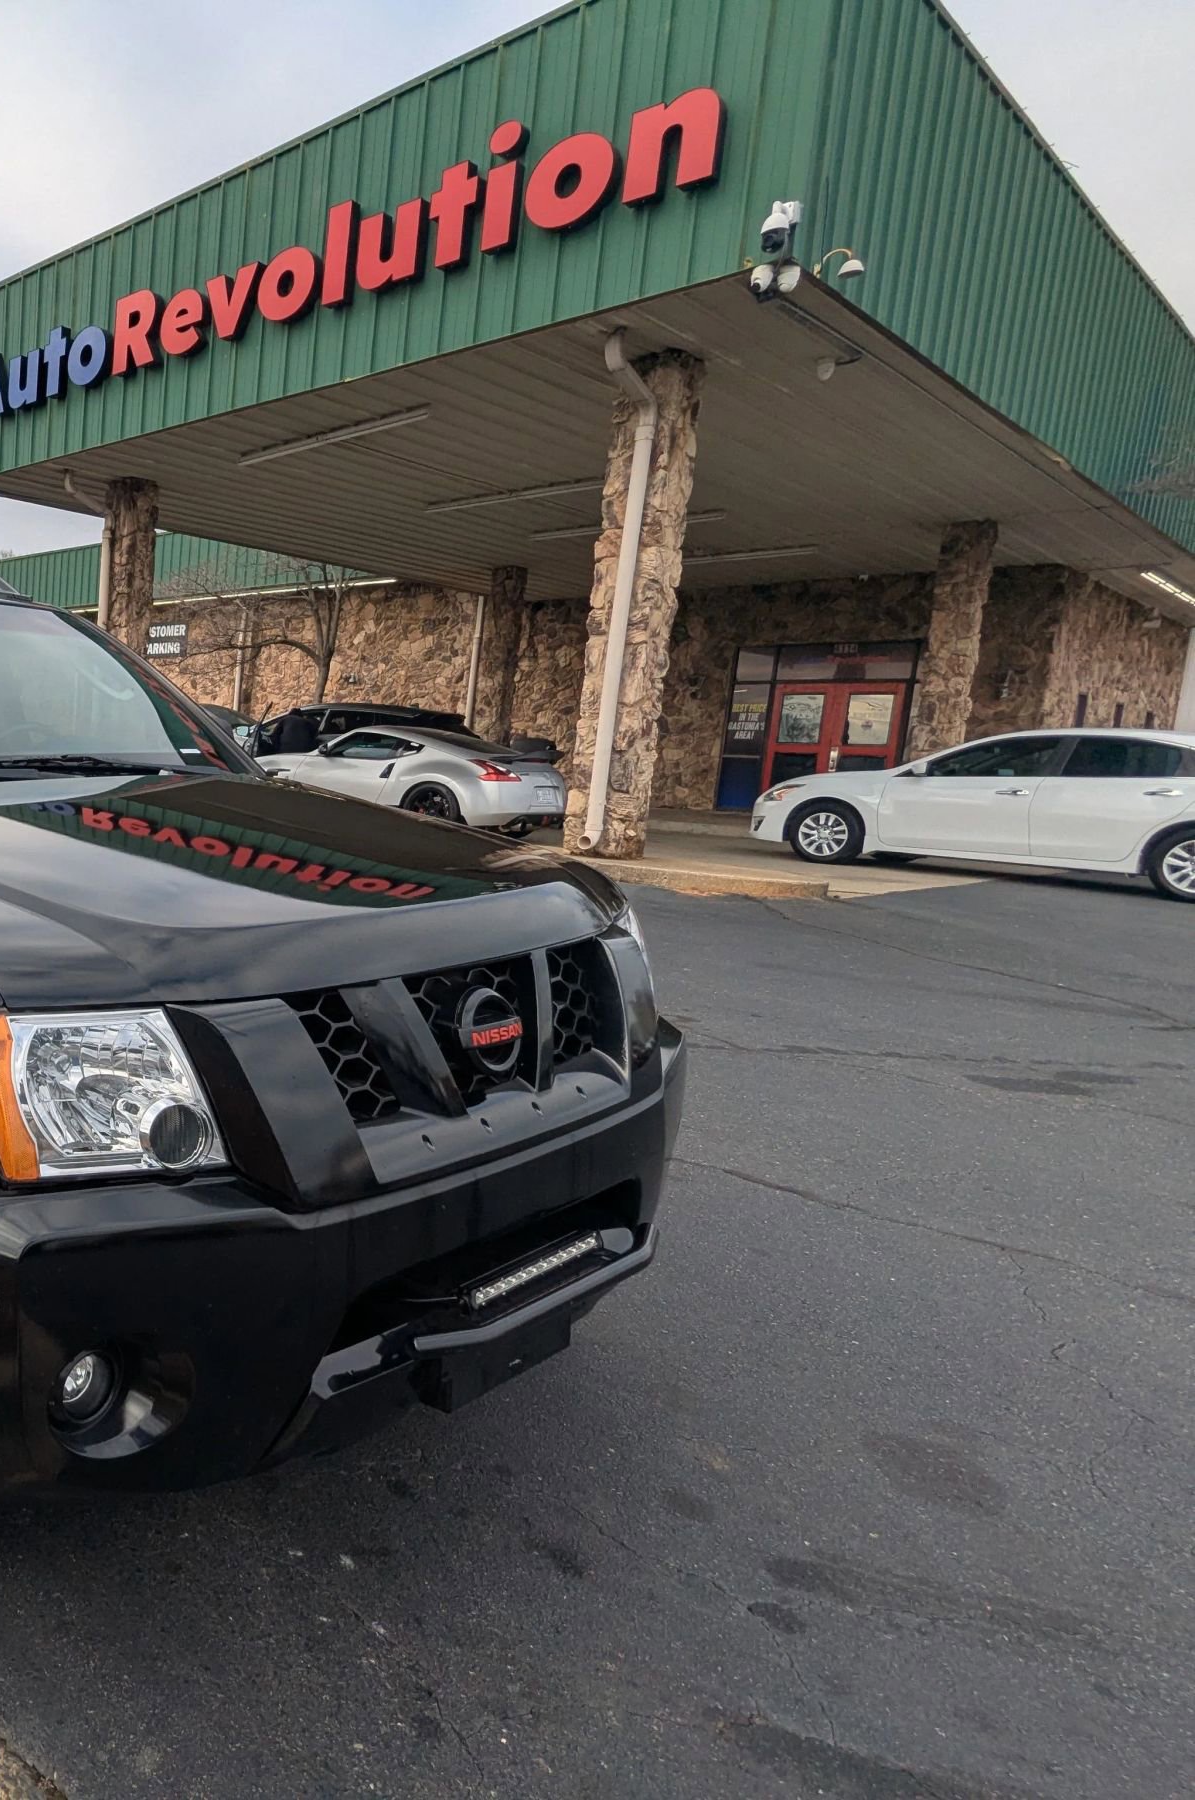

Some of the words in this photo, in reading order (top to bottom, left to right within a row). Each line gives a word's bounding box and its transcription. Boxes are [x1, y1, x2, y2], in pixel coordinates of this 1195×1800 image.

[149, 624, 187, 638] STOMER
[146, 641, 181, 655] ARKING
[747, 712, 760, 721] THE
[471, 1022, 523, 1047] NISSAN
